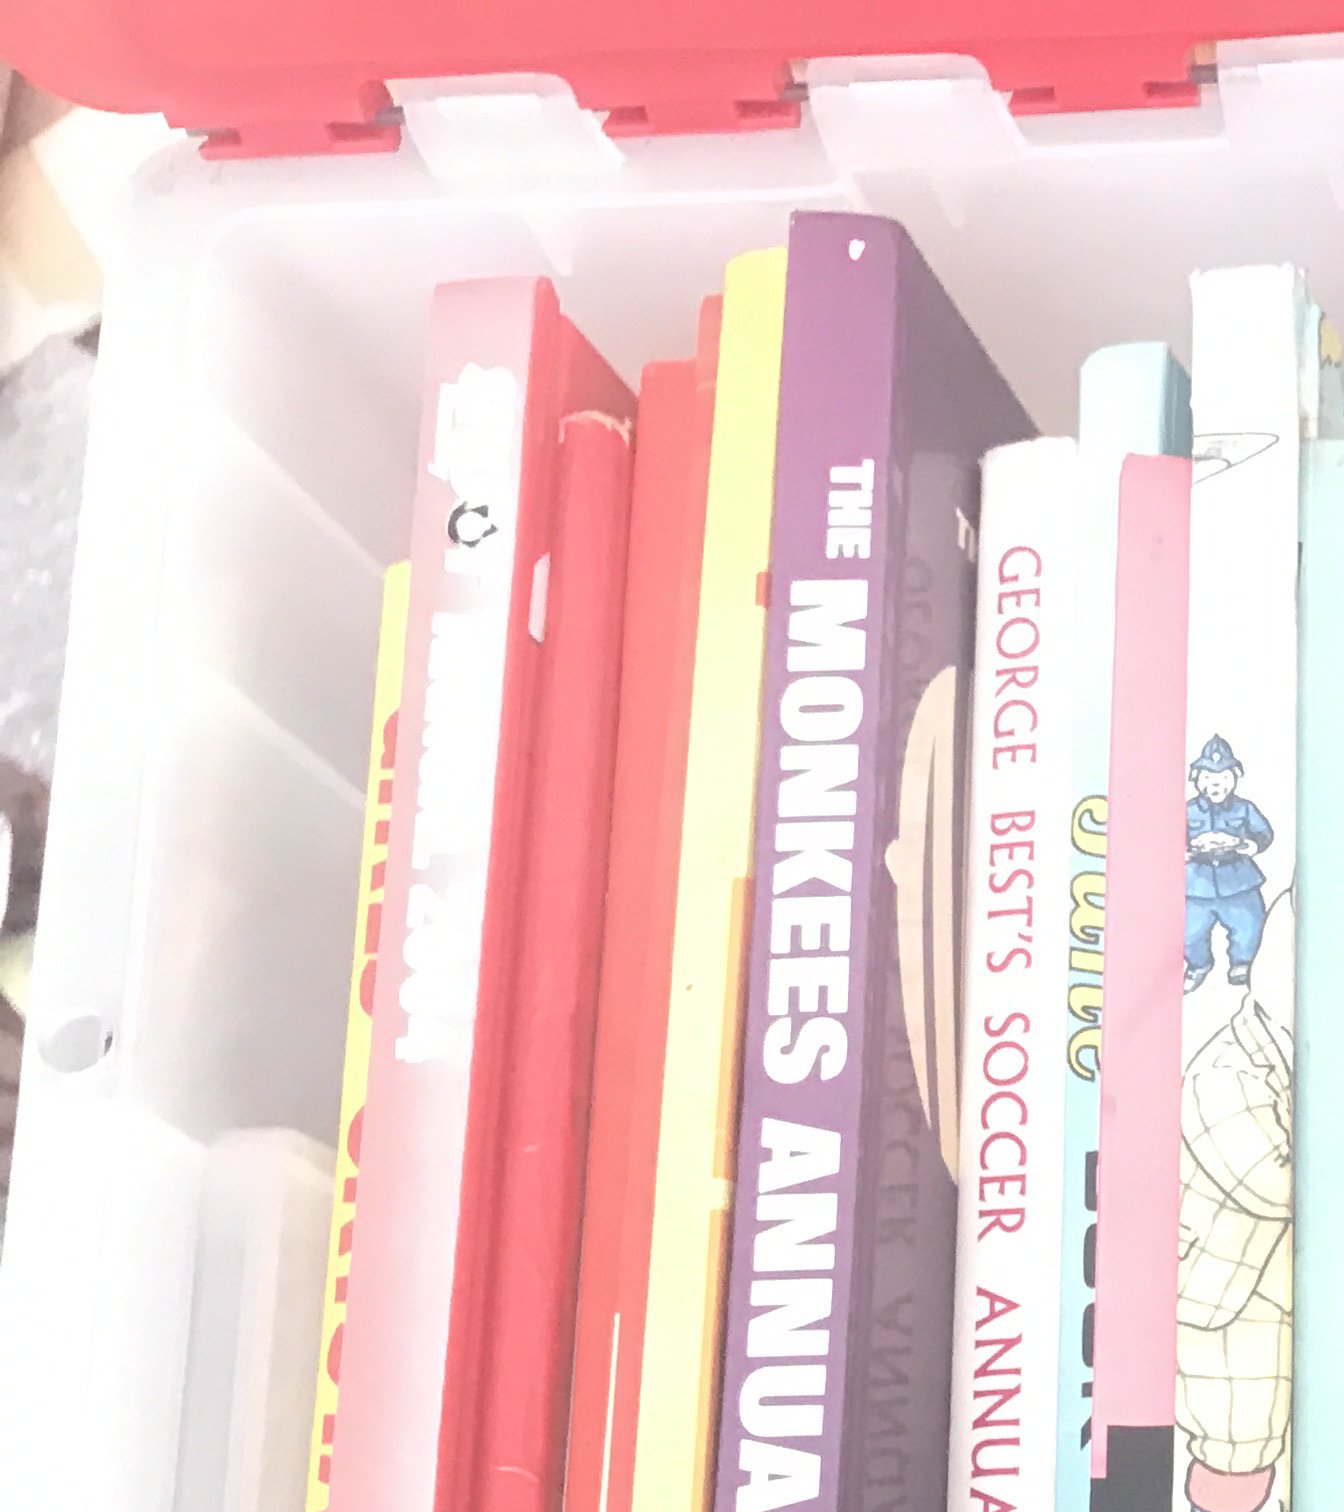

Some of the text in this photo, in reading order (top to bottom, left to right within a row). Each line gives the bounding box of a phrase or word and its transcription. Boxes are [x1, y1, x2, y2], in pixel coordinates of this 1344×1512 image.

[824, 459, 875, 561] THE
[992, 546, 1042, 770] GEORGE
[763, 580, 869, 1085] MONKEES
[986, 810, 1036, 973] BEST'S
[978, 1013, 1030, 1242] SOCCER
